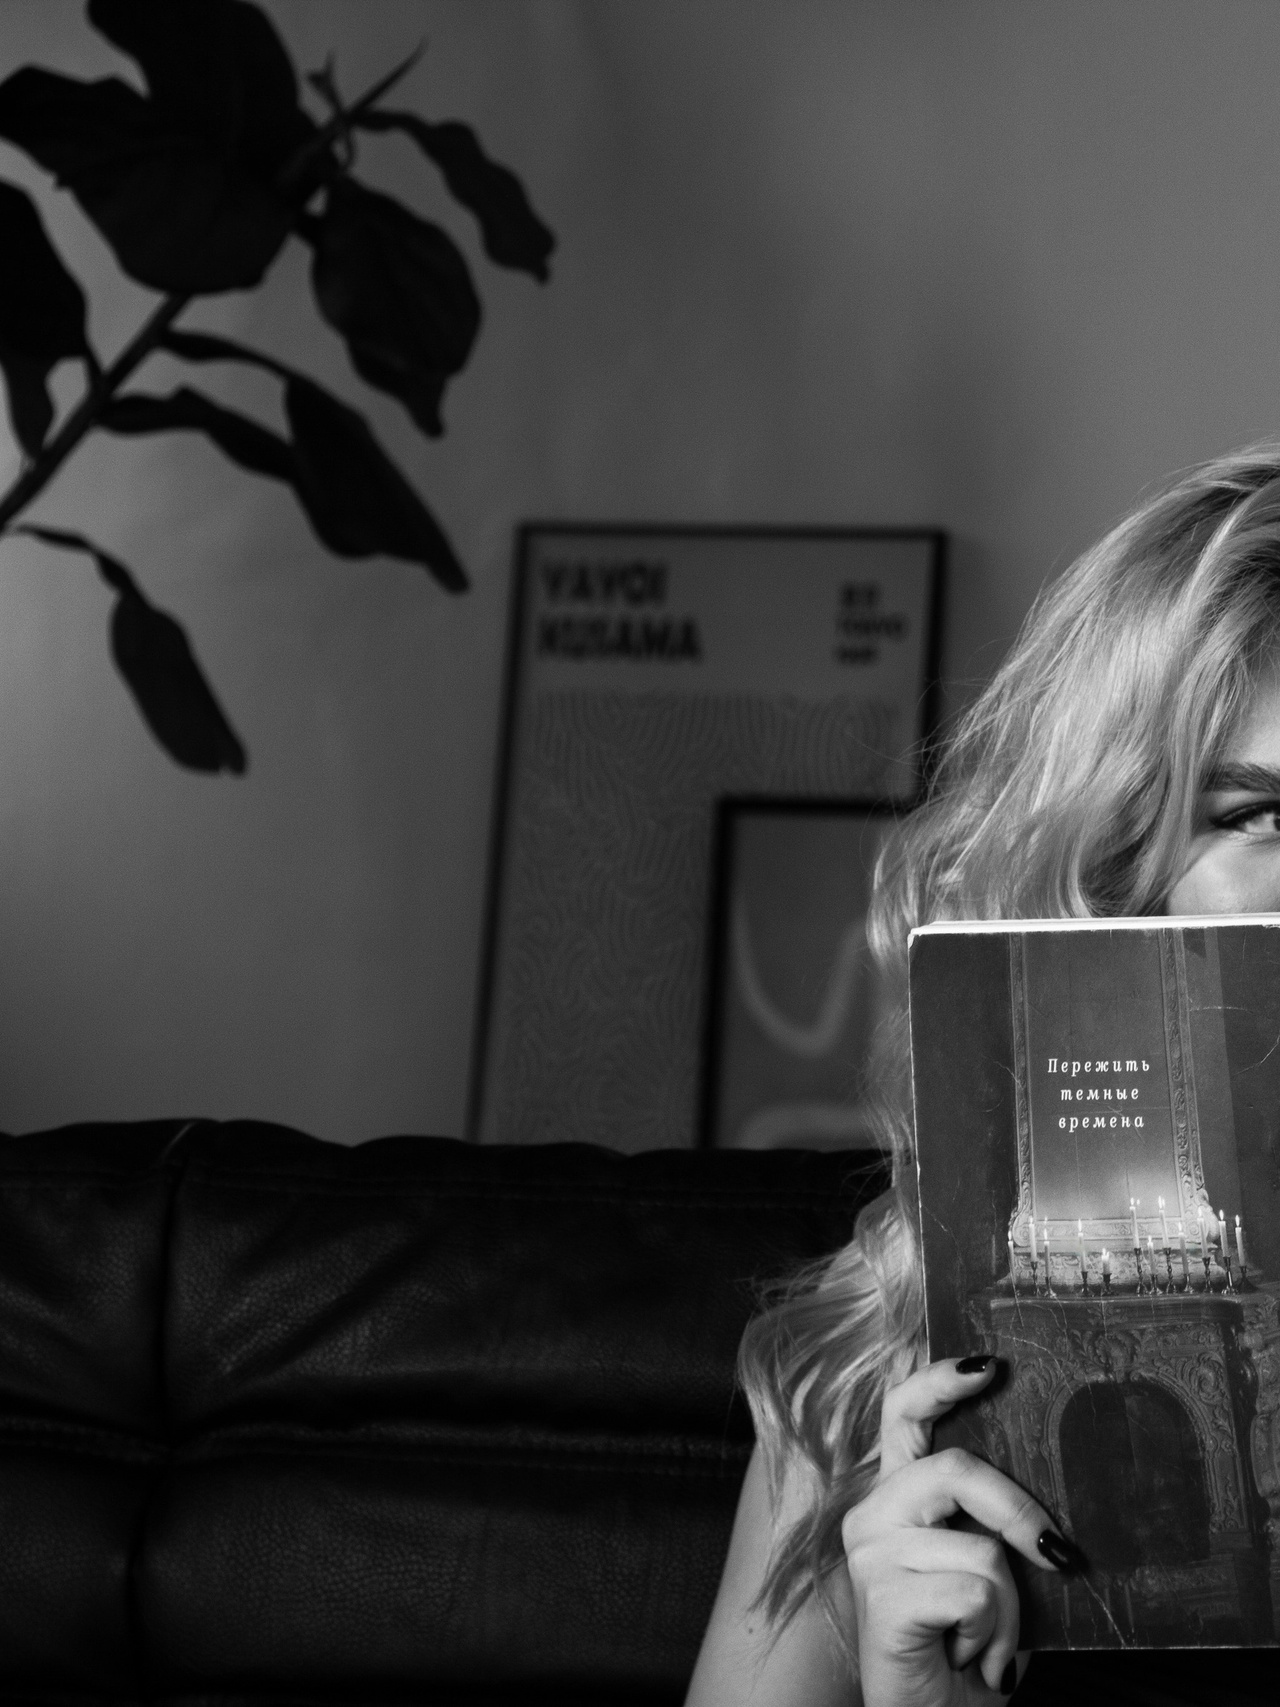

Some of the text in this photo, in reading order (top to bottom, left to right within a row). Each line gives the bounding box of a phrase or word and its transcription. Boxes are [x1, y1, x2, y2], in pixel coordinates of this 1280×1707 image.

[1047, 1058, 1150, 1077] Пережить
[1060, 1087, 1139, 1101] темные
[1058, 1115, 1145, 1133] времена
